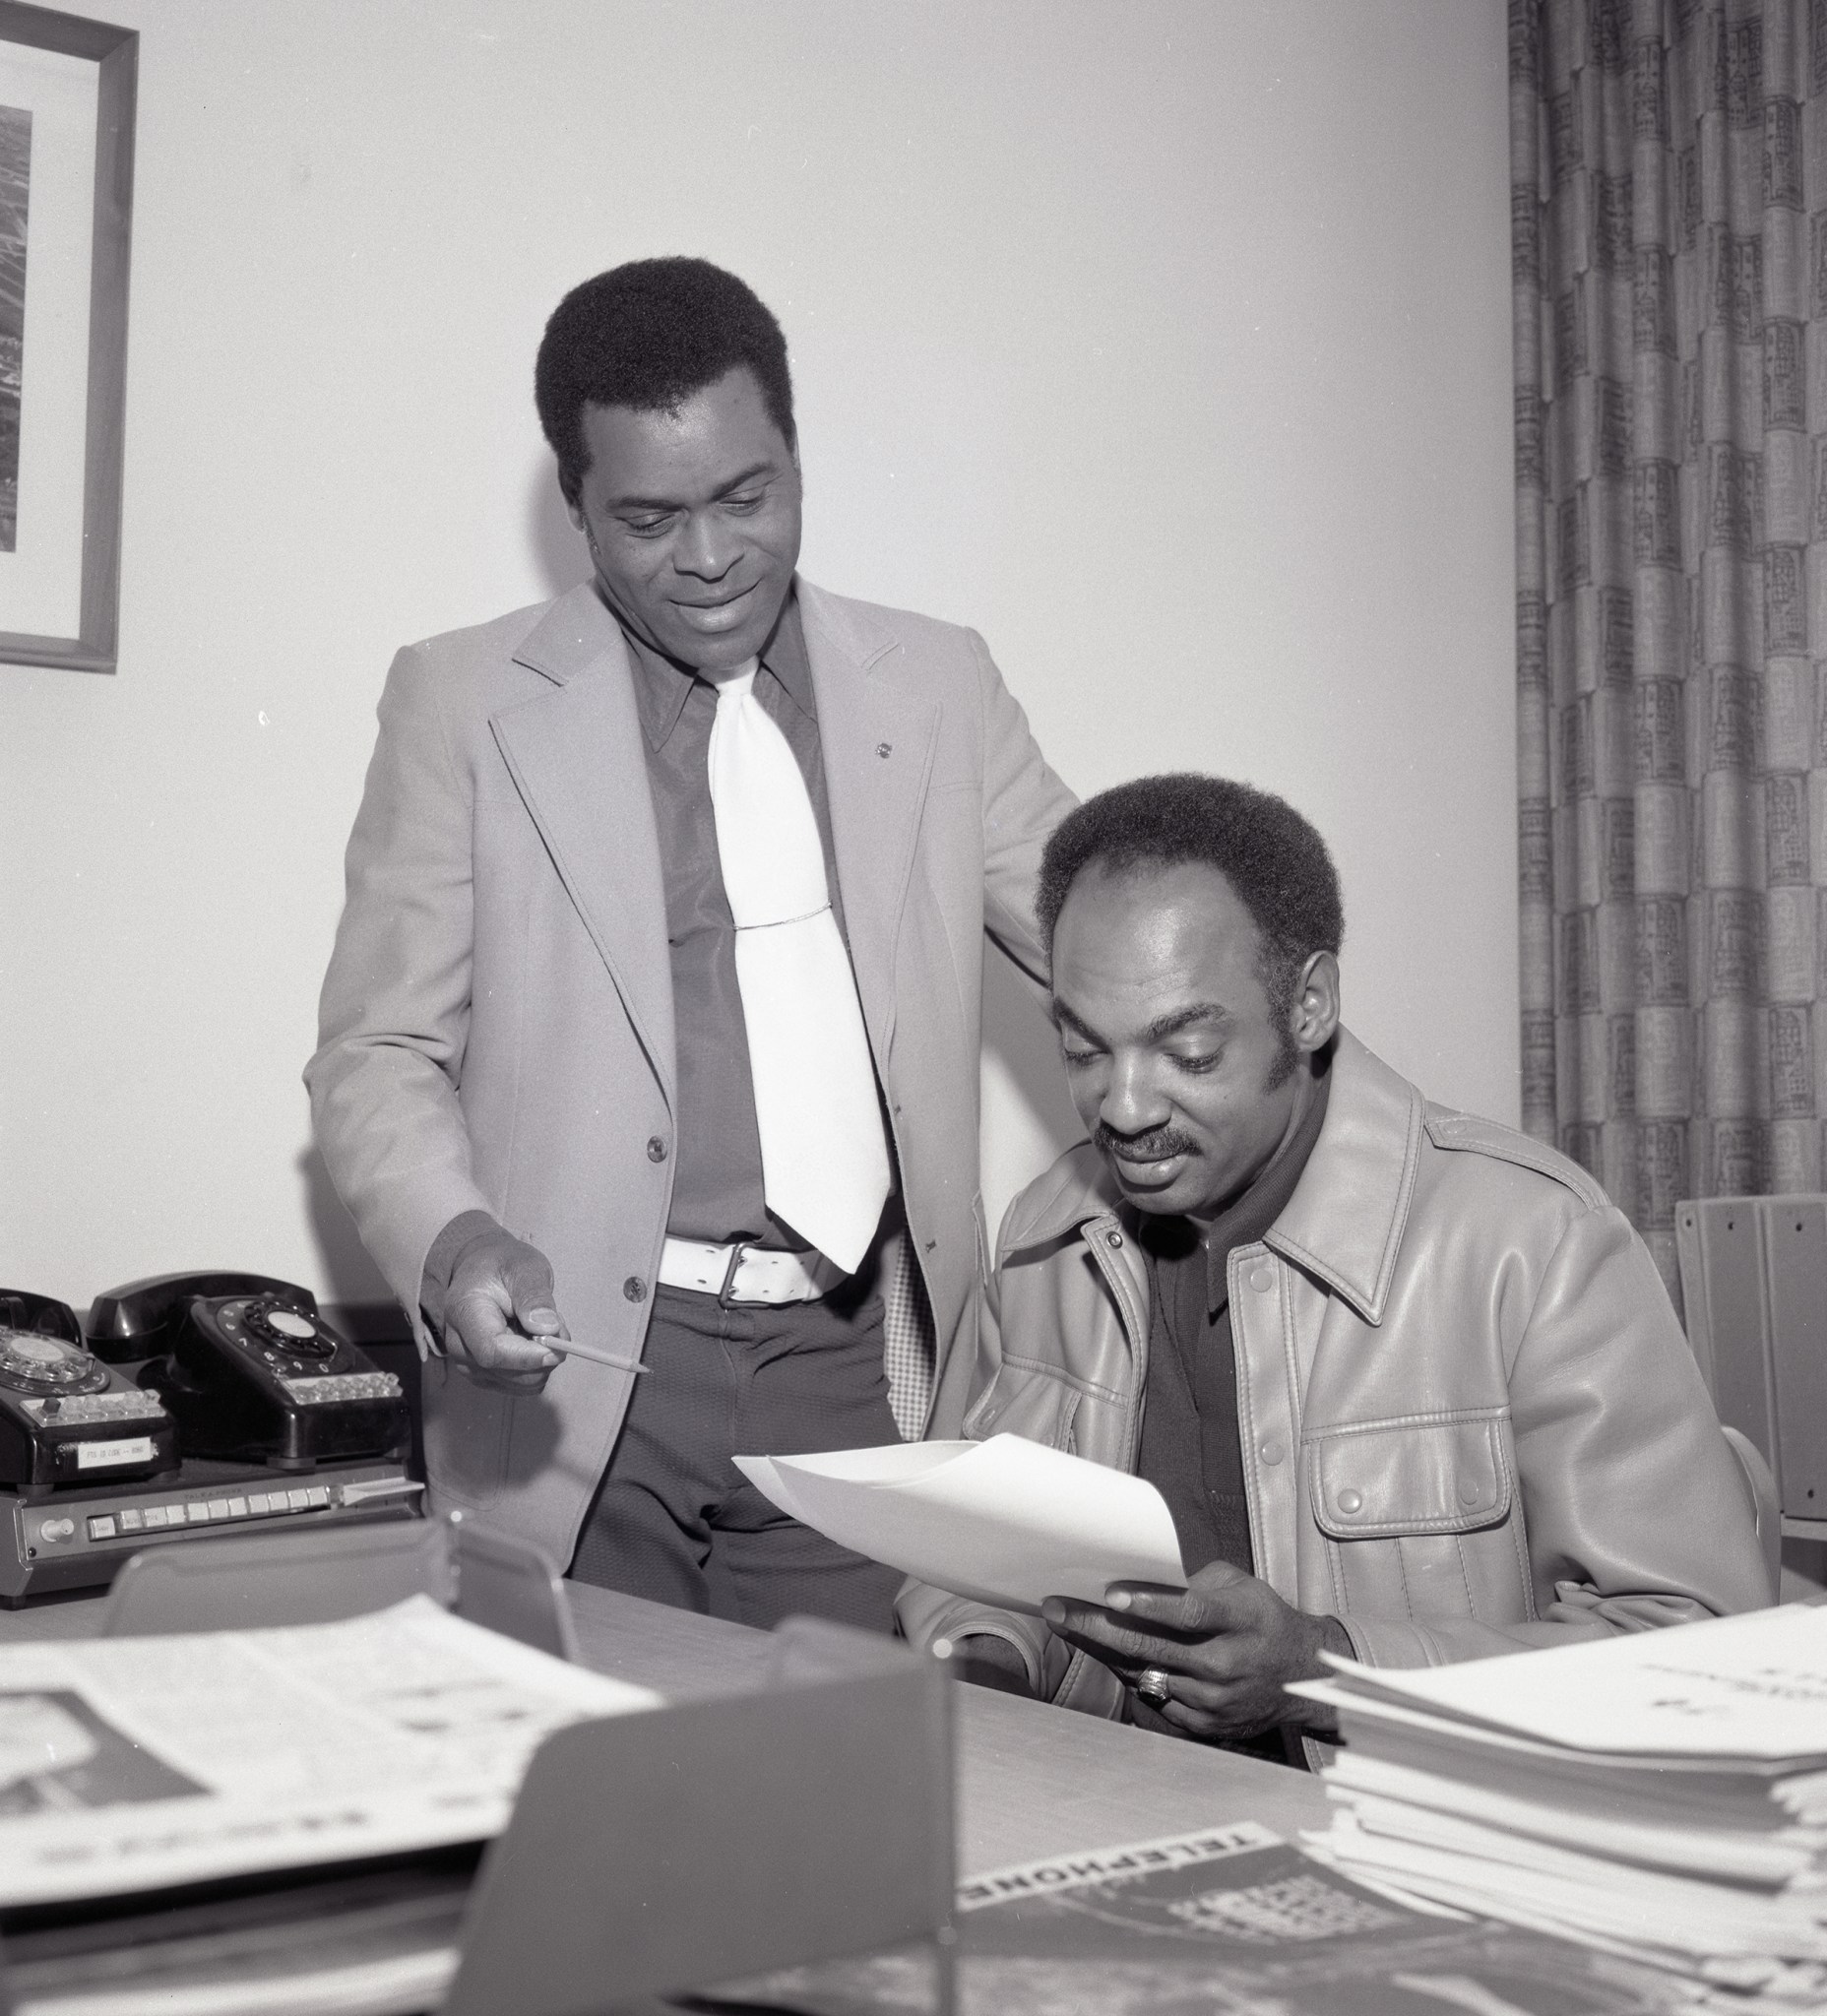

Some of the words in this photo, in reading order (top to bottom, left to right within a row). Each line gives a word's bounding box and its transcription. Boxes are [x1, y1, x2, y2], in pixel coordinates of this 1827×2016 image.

[264, 1352, 276, 1361] 8
[293, 1360, 302, 1371] 9
[960, 1834, 1259, 1901] TELEPHONE
